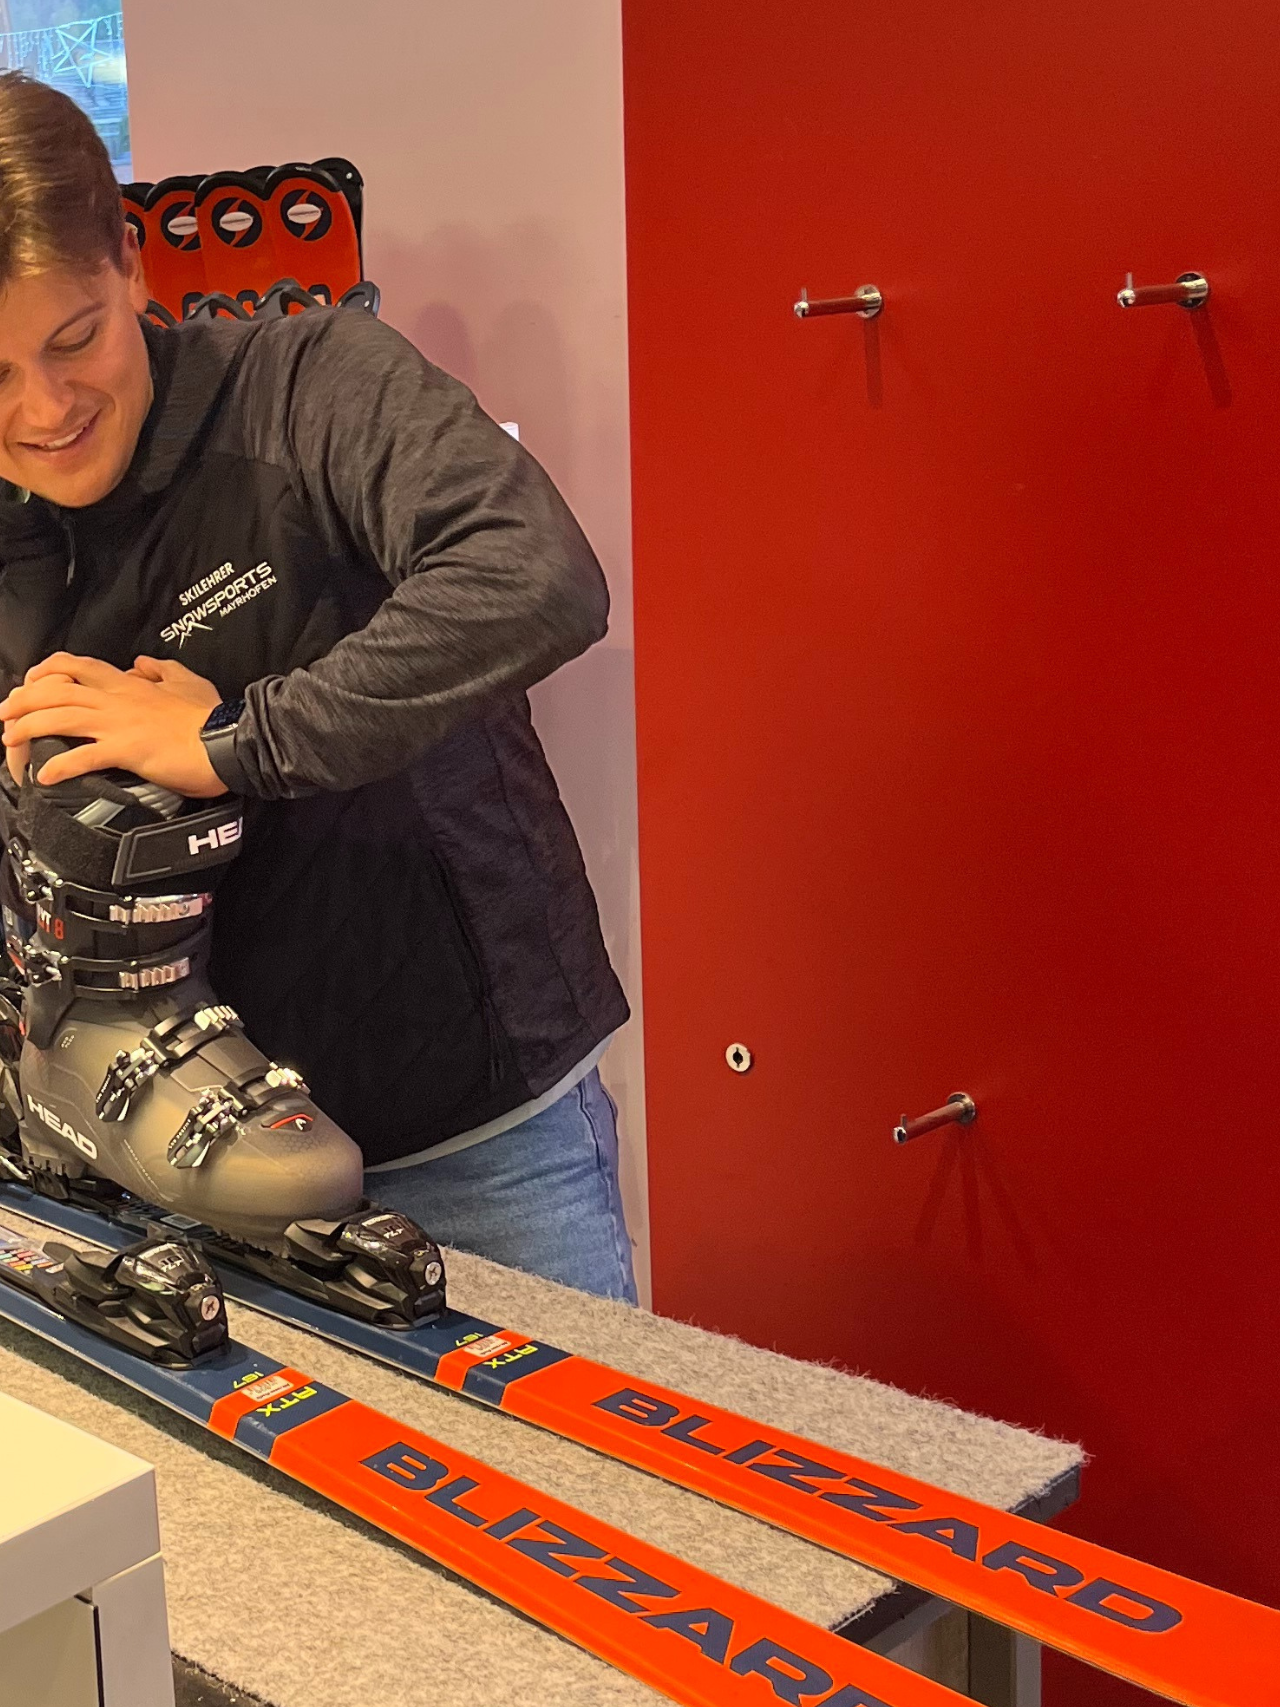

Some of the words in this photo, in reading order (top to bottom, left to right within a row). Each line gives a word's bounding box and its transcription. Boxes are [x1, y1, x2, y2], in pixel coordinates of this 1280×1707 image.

[160, 561, 272, 642] SNOWSPORTS
[179, 562, 235, 606] SKILEHRER
[219, 576, 278, 617] MAYRHOFEN
[55, 918, 64, 940] 8
[26, 1094, 98, 1160] HEAD
[482, 1344, 538, 1369] ATX
[255, 1386, 318, 1418] ATX
[592, 1387, 1184, 1635] BLIZZARD
[358, 1441, 896, 1707] BLIZZAR
